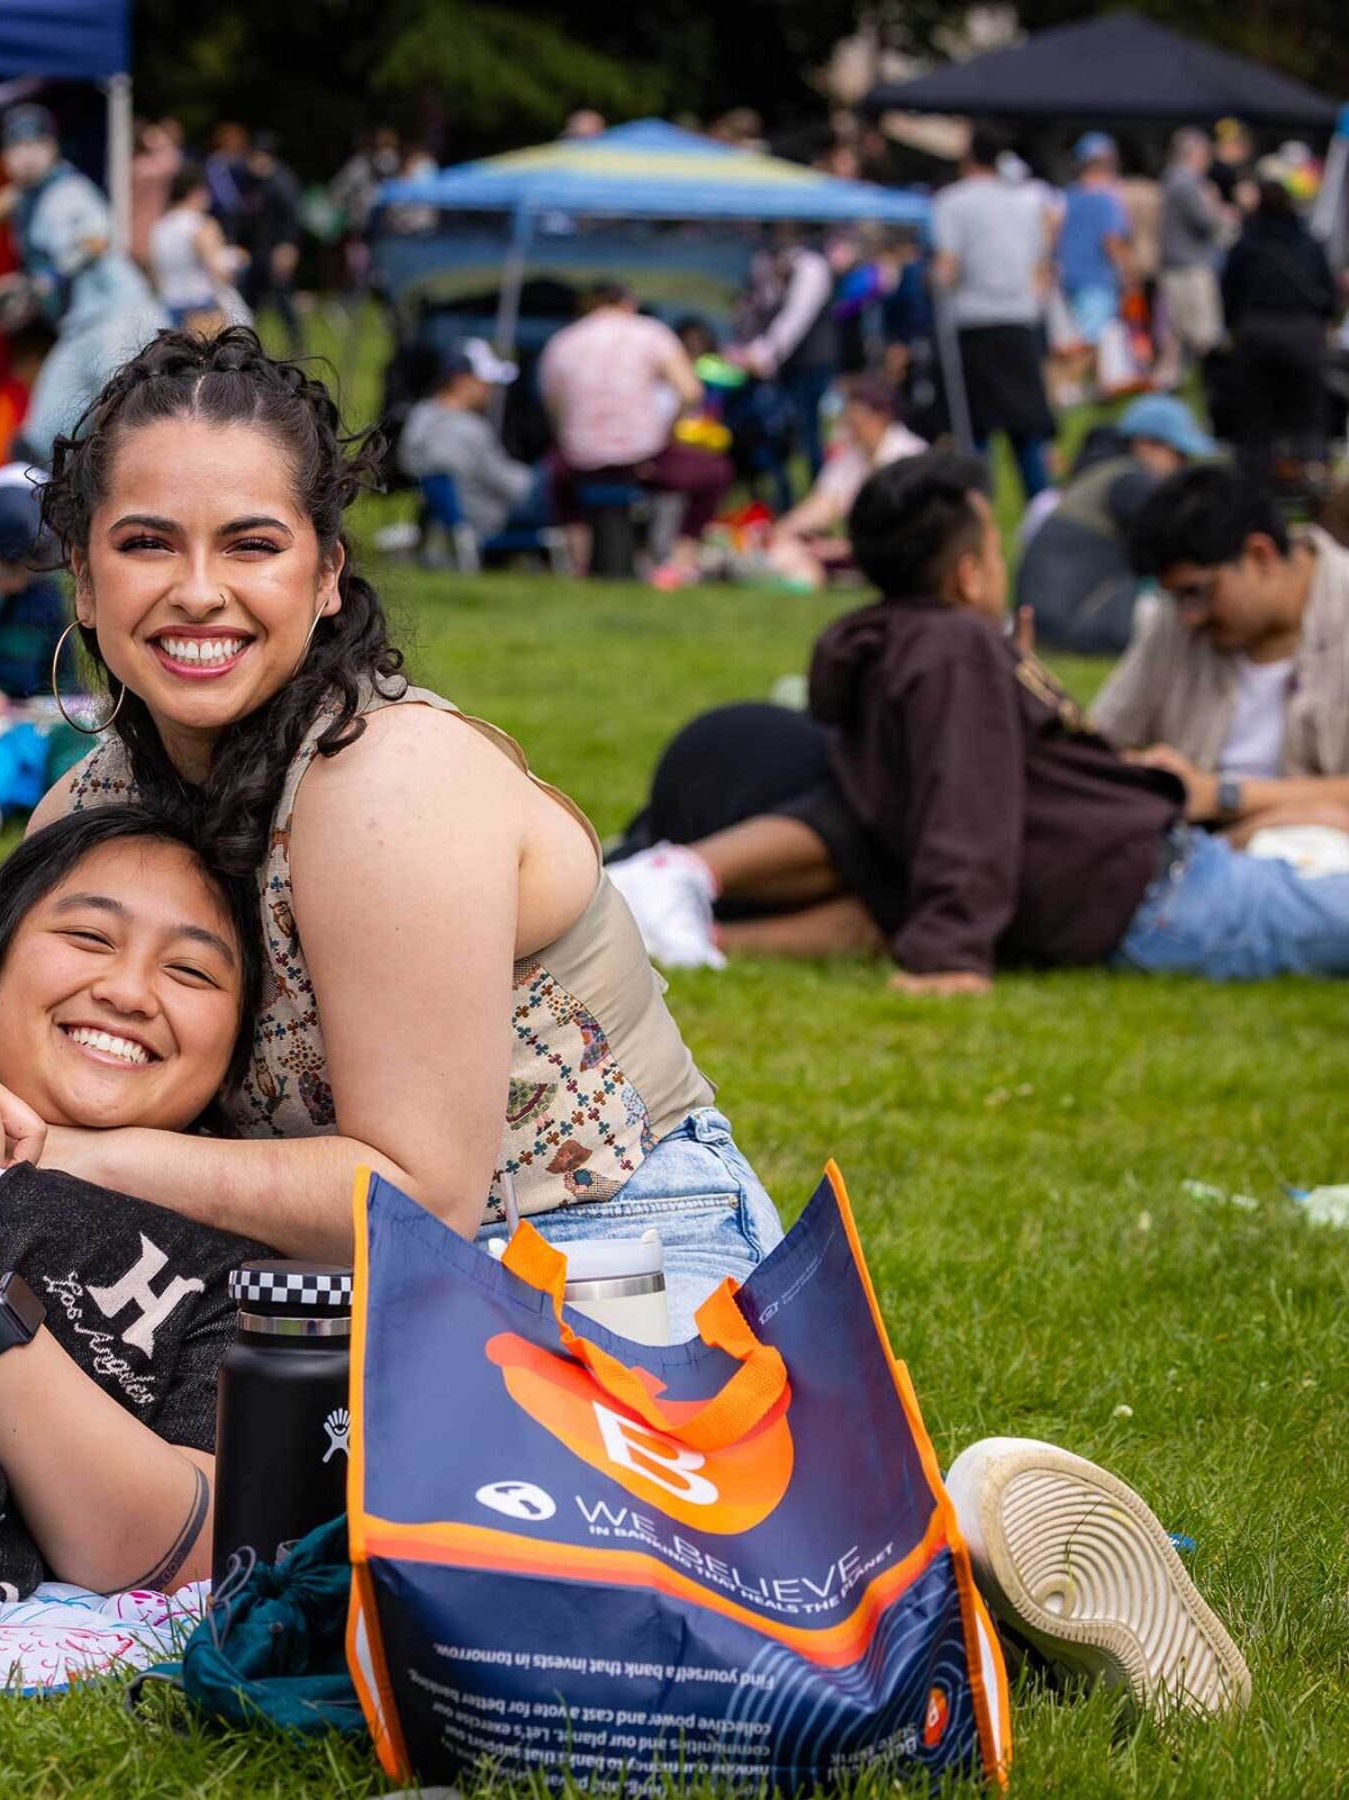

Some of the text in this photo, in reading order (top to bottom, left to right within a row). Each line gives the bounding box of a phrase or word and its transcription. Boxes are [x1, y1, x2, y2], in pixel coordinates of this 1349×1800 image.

[85, 1231, 206, 1360] H
[42, 1270, 155, 1404] Los Angeles
[593, 1401, 719, 1505] B
[575, 1495, 861, 1603] WE BELIEVE
[589, 1525, 894, 1614] IN BANKING THAT HEALS THE PLANET
[432, 1642, 775, 1690] Find yourself a bank that invests in tomorrow.
[431, 1700, 453, 1717] our
[460, 1692, 505, 1714] better
[506, 1700, 530, 1718] for
[532, 1702, 566, 1718] vote
[568, 1706, 579, 1718] a
[582, 1706, 613, 1722] cast
[615, 1709, 646, 1726] and
[648, 1712, 695, 1728] power
[453, 1710, 510, 1734] exercise
[697, 1716, 771, 1736] collective
[513, 1724, 548, 1740] Let's
[608, 1733, 635, 1748] our
[637, 1736, 666, 1752] and
[523, 1748, 554, 1764] that
[605, 1756, 623, 1770] to
